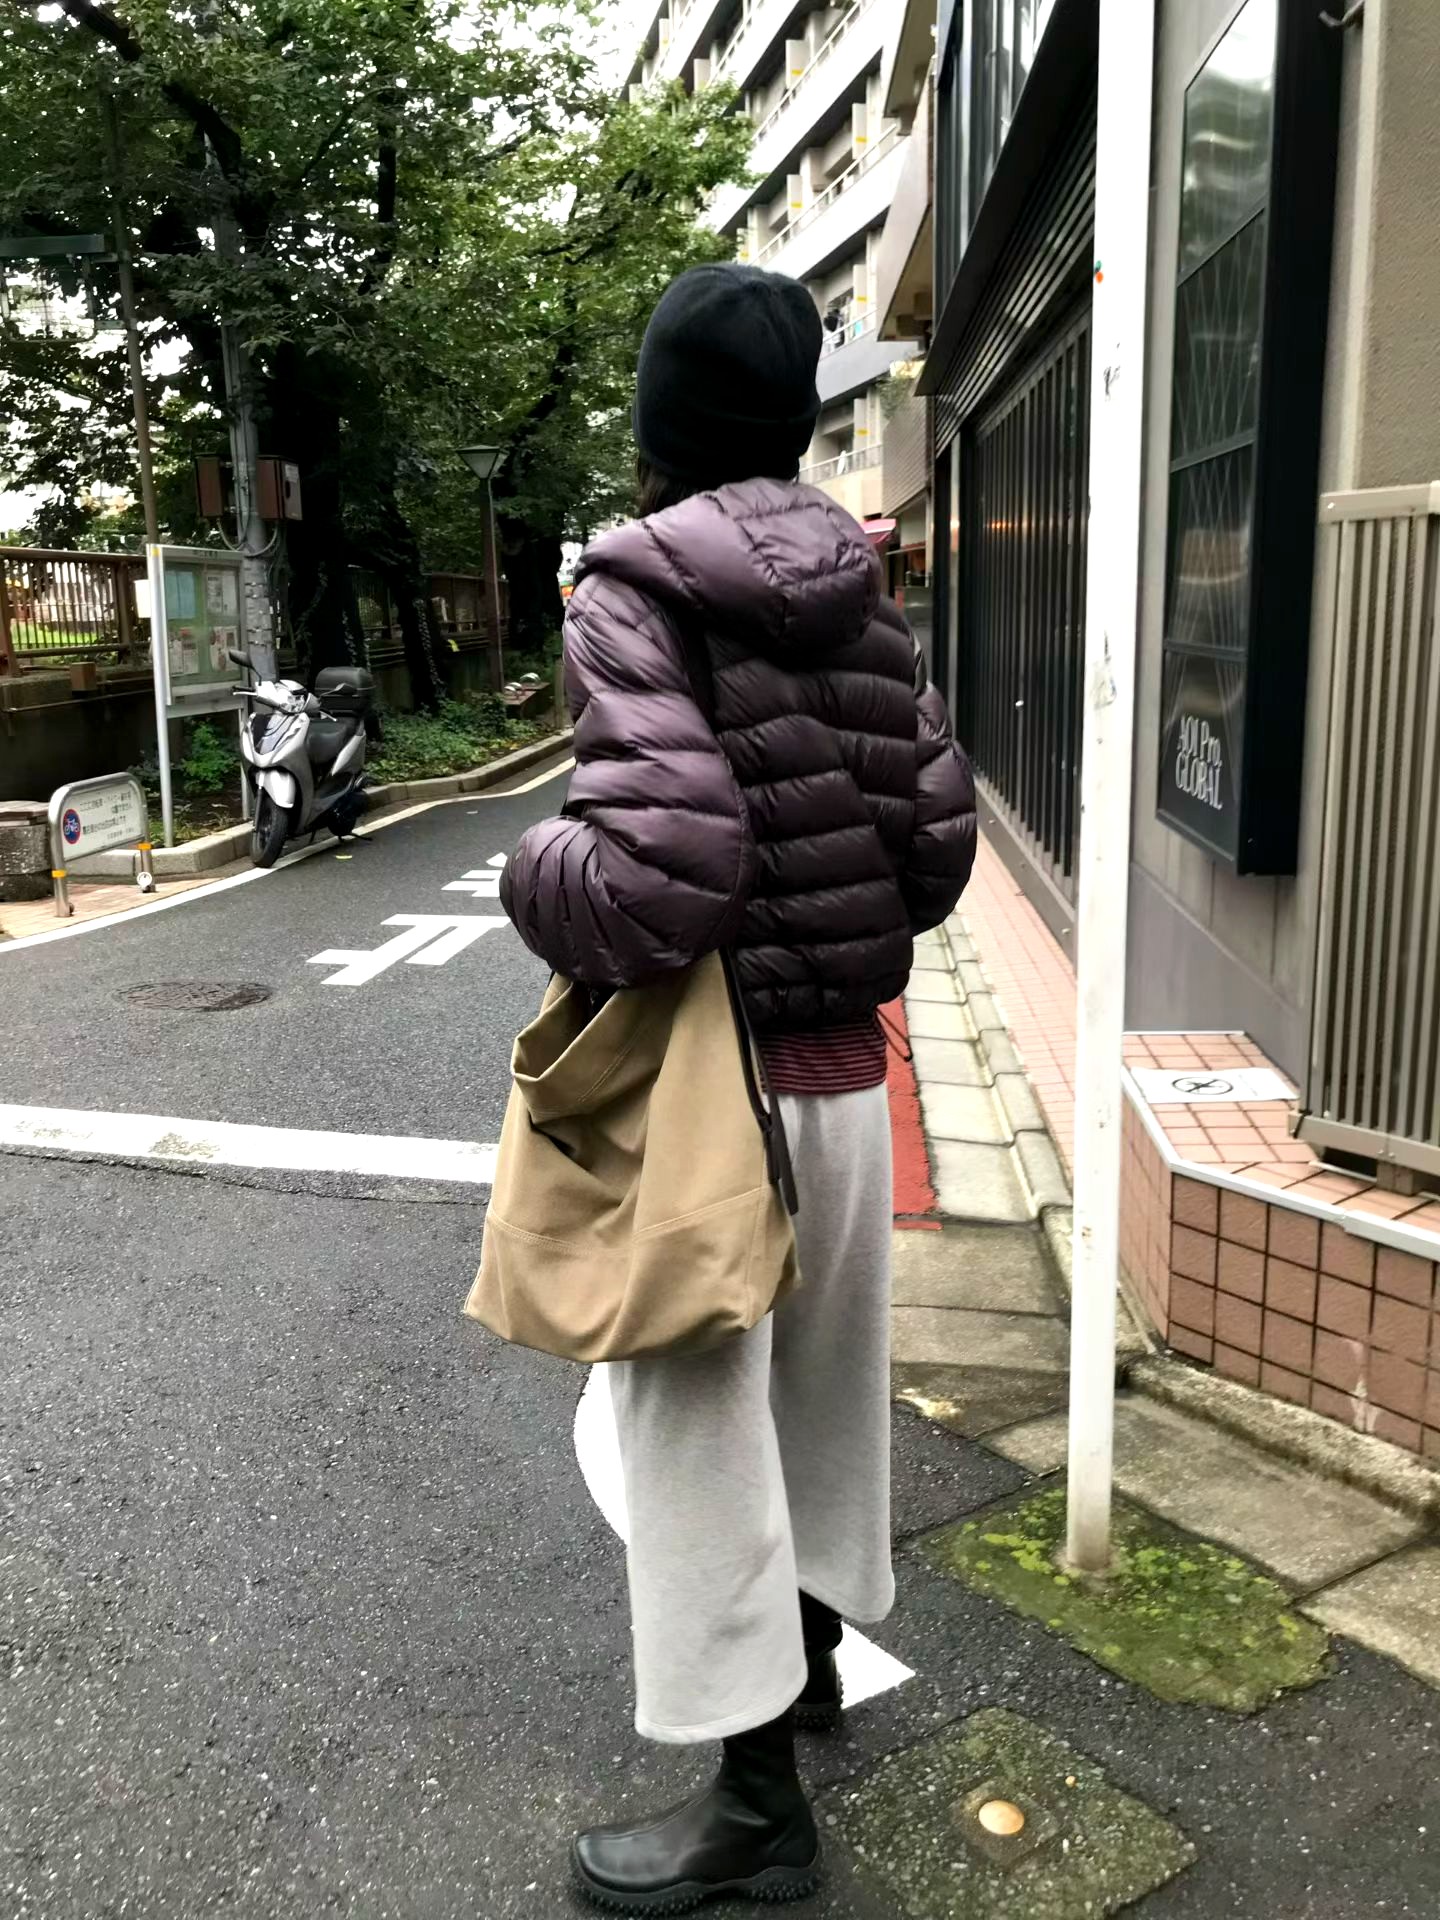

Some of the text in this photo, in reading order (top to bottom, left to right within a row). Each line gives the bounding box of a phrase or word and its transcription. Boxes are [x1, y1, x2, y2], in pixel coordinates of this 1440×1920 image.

[1177, 715, 1223, 767] AOI Pro.
[1175, 751, 1223, 811] GLOBAL
